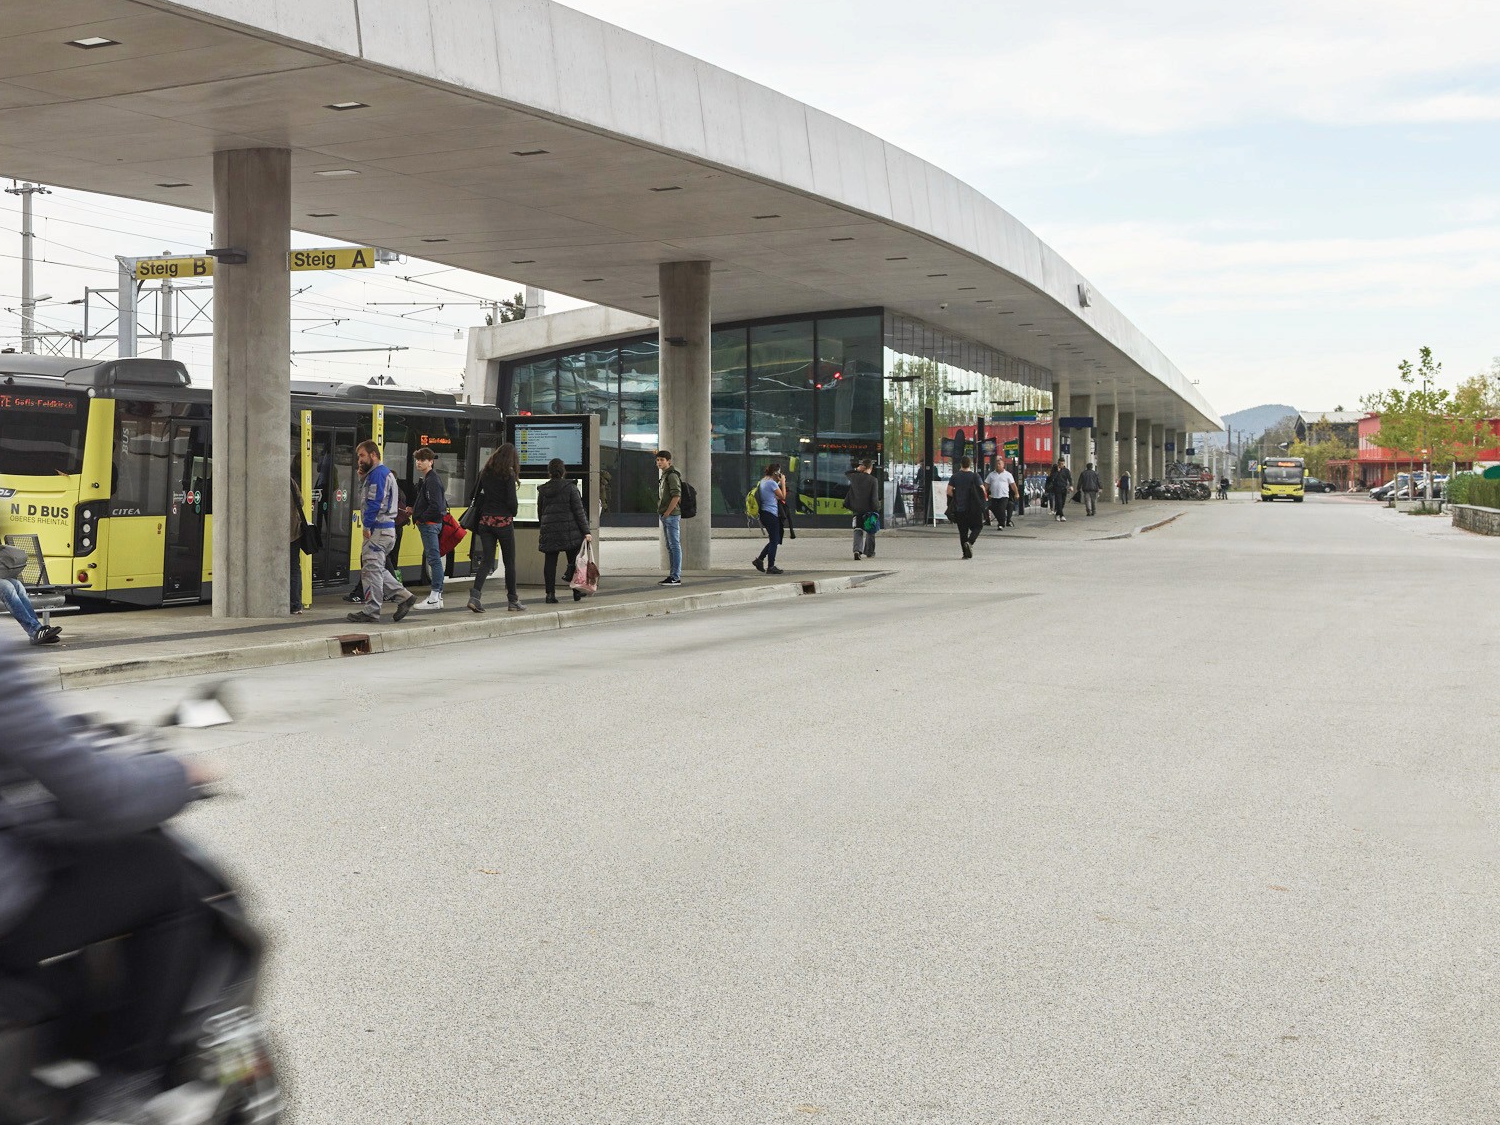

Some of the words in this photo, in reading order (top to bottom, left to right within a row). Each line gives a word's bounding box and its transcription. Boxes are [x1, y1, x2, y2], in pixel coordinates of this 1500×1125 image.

[139, 260, 178, 277] Steig
[193, 258, 207, 276] B
[294, 251, 336, 268] Steig
[351, 249, 367, 268] A
[9, 515, 36, 524] OBERES
[37, 517, 69, 526] RHEINTAL
